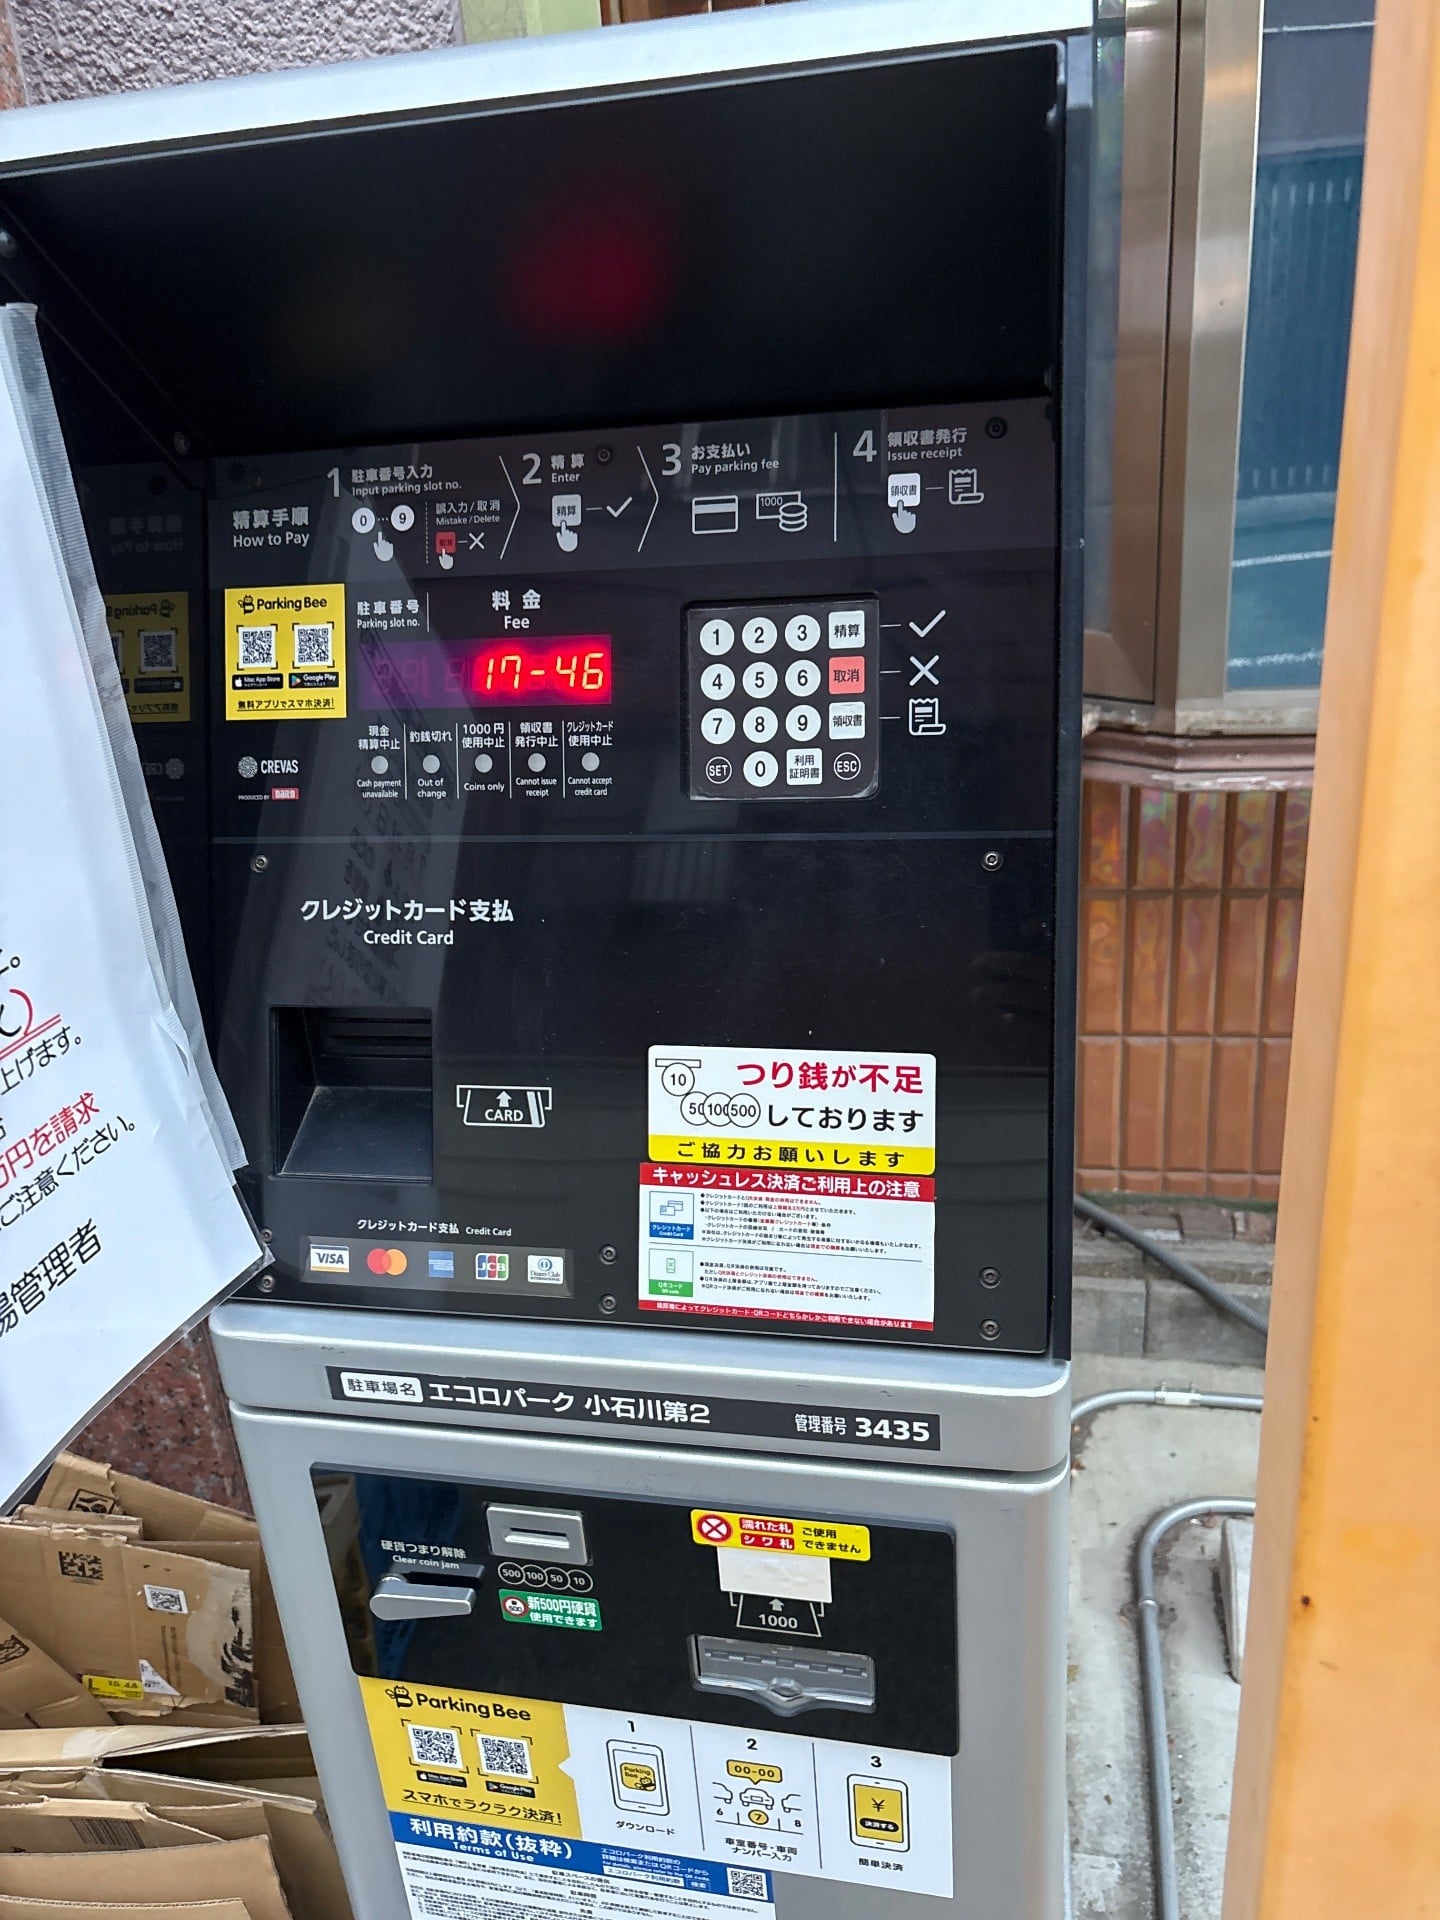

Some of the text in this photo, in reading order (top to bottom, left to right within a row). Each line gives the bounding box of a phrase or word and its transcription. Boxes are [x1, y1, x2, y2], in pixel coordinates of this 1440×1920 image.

[887, 428, 968, 446] 領収書発行
[691, 443, 751, 460] お支払い
[853, 430, 878, 462] 4
[888, 445, 962, 461] Issue receipt
[550, 453, 585, 471] 精算
[661, 443, 682, 476] 3
[691, 457, 780, 476] Pay parking fee
[351, 464, 433, 484] 駐車番号入力
[522, 453, 542, 485] 2
[326, 467, 341, 497] 1
[551, 471, 580, 484] Enter
[352, 480, 462, 498] Input parking slot no.
[890, 484, 917, 497] 領収書
[760, 495, 784, 507] 1000
[232, 506, 310, 531] 精算手順
[556, 505, 577, 518] 精算
[359, 512, 408, 527] 0 9
[233, 531, 310, 549] How to Pay
[357, 599, 420, 616] 駐車番号
[491, 589, 542, 611] 料金
[357, 616, 421, 631] Parking slot no.
[504, 615, 530, 630] Fee
[713, 629, 720, 645] 1
[754, 627, 764, 643] 2
[797, 624, 807, 641] 3
[834, 623, 861, 639] 精算
[303, 674, 336, 682] Google Play
[712, 674, 723, 690] 4
[754, 672, 764, 688] 5
[797, 670, 808, 686] 6
[833, 668, 860, 683] 取消
[520, 721, 553, 734] 領収書
[566, 720, 614, 732] クレジットカード
[713, 718, 723, 734] 7
[754, 716, 765, 733] 8
[797, 715, 808, 731] 9
[832, 714, 862, 728] 領収書
[368, 725, 389, 736] 現金
[409, 731, 452, 743] 釣銭切れ
[358, 738, 400, 750] 精算中止
[462, 736, 505, 748] 使用中止
[515, 735, 559, 748] 発行中止
[568, 734, 613, 747] 使用中止
[261, 759, 298, 774] CREVAS
[794, 755, 814, 765] 利用
[837, 760, 858, 772] ESC
[709, 764, 728, 777] SET
[755, 761, 765, 777] 0
[789, 767, 820, 779] 証明書
[357, 778, 402, 789] Cash payment
[417, 777, 444, 787] Out of
[464, 781, 505, 792] Coins only
[515, 777, 557, 786] Cannot issue
[568, 776, 613, 786] Cannot accept
[362, 789, 399, 798] unavailable
[417, 789, 447, 799] change
[526, 788, 549, 797] receipt
[574, 787, 608, 796] credit card
[300, 898, 514, 922] クレジットカード支払
[363, 930, 454, 945] Credit Card
[670, 1073, 687, 1086] 10
[736, 1061, 924, 1095] つり銭が不足
[484, 1107, 524, 1122] CARD
[730, 1104, 757, 1118] 500
[767, 1104, 924, 1133] しております
[677, 1142, 905, 1168] ご協力お願いします
[652, 1167, 921, 1198] キャッシュレス決済ご利用上の注意
[356, 1219, 460, 1234] クレジットカード支払
[465, 1226, 512, 1237] Credit Card
[316, 1252, 344, 1264] VISA
[478, 1262, 506, 1272] JCB
[658, 1281, 683, 1289] QRコード
[347, 1378, 417, 1398] 駐車場名
[428, 1382, 711, 1425] エコロパーク 小石川第2
[795, 1414, 930, 1441] 管理番号 3435
[741, 1518, 792, 1533] 濡れた札
[802, 1527, 837, 1539] ご使用
[380, 1539, 467, 1559] 硬貨つまり解除
[743, 1535, 793, 1548] シワ札
[802, 1540, 861, 1553] できません
[392, 1555, 460, 1570] Clear coin jam
[502, 1568, 585, 1586] 500 100 50 10
[527, 1596, 597, 1617] 新500円硬貨
[529, 1612, 597, 1627] 使用できます
[758, 1613, 798, 1629] 1000
[627, 1720, 635, 1732] 1
[746, 1738, 757, 1750] 2
[870, 1755, 882, 1768] 3
[624, 1766, 652, 1776] Parking
[734, 1764, 775, 1778] 00-00
[403, 1789, 562, 1823] スマホでラクラク決済!
[871, 1798, 885, 1812] ¥
[616, 1820, 675, 1835] ダウンロード
[754, 1813, 762, 1821] 7
[794, 1819, 801, 1827] 8
[409, 1818, 572, 1859] 利用約款(抜粋)
[725, 1837, 797, 1855] 車室番号・車両
[453, 1842, 535, 1862] Terms of Use
[732, 1847, 792, 1861] ナンバー入力
[858, 1858, 904, 1871] 簡単決済
